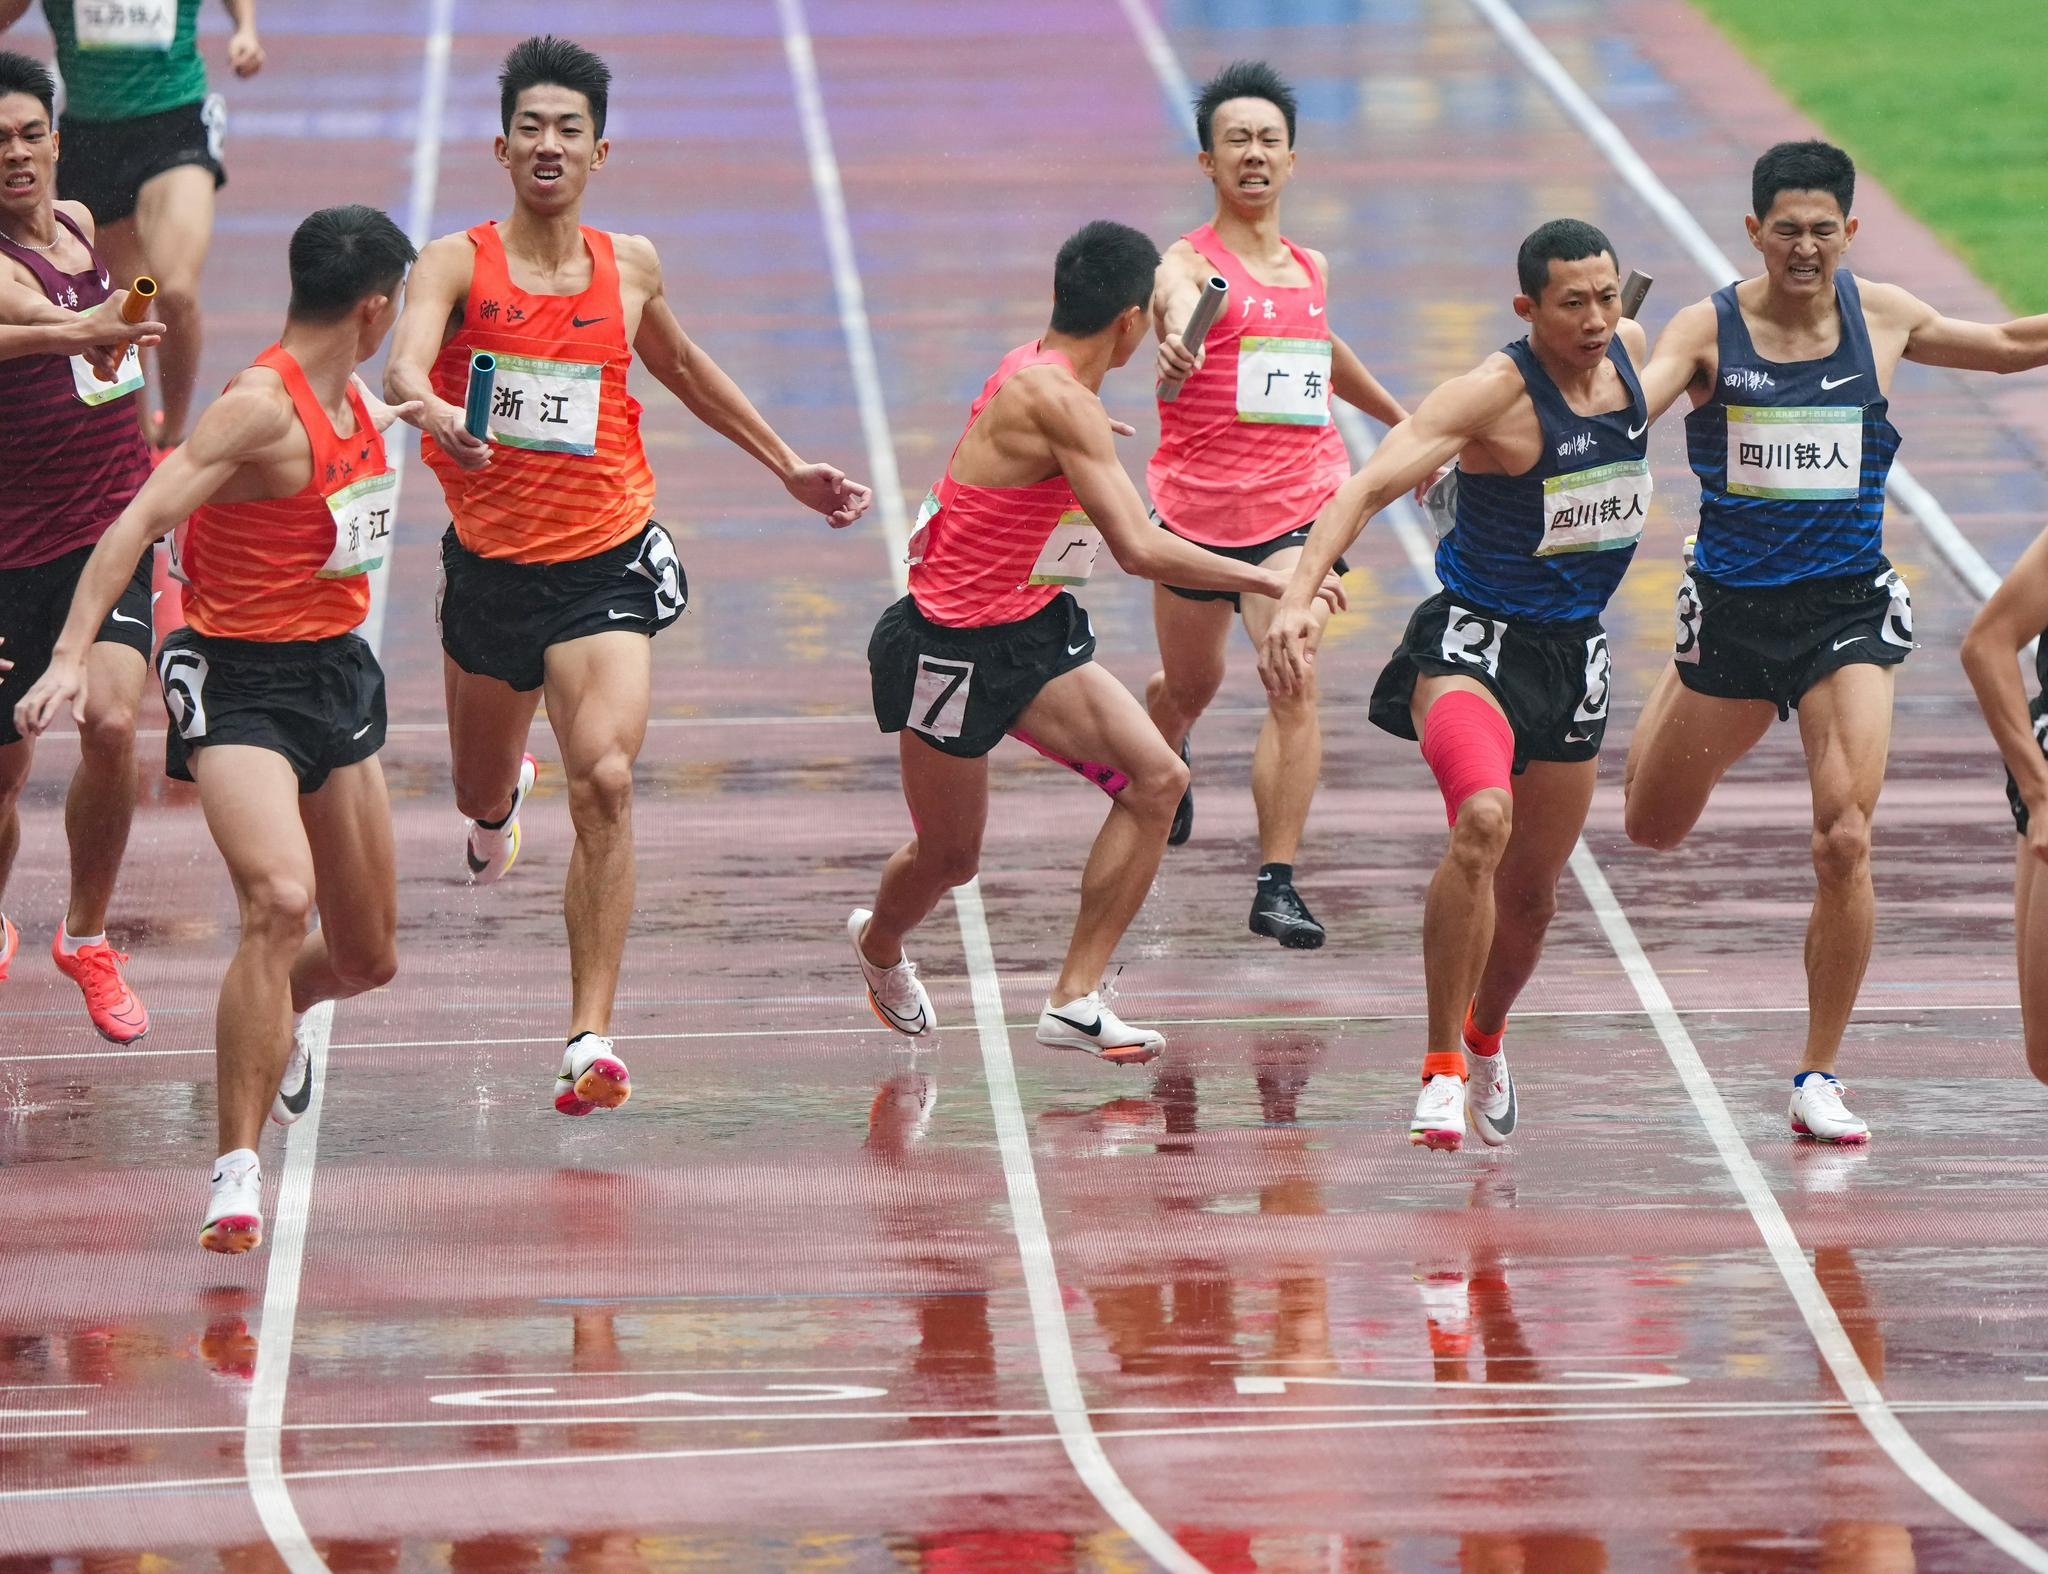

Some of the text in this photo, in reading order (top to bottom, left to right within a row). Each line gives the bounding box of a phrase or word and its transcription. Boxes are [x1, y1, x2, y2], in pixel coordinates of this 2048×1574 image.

[57, 286, 79, 308] 上海
[480, 299, 526, 323] 浙江
[1242, 295, 1277, 319] 广东
[1264, 369, 1322, 399] 广东
[1723, 371, 1775, 392] 四川铁人
[492, 386, 569, 424] 浙江
[1556, 431, 1598, 457] 四川铁人
[1739, 442, 1849, 470] 四川铁人
[1550, 493, 1644, 531] 四川铁人
[348, 508, 391, 553] 浙江
[1057, 538, 1102, 563] 广
[1582, 637, 1611, 715] 3
[163, 654, 202, 734] 5
[920, 660, 970, 730] 7
